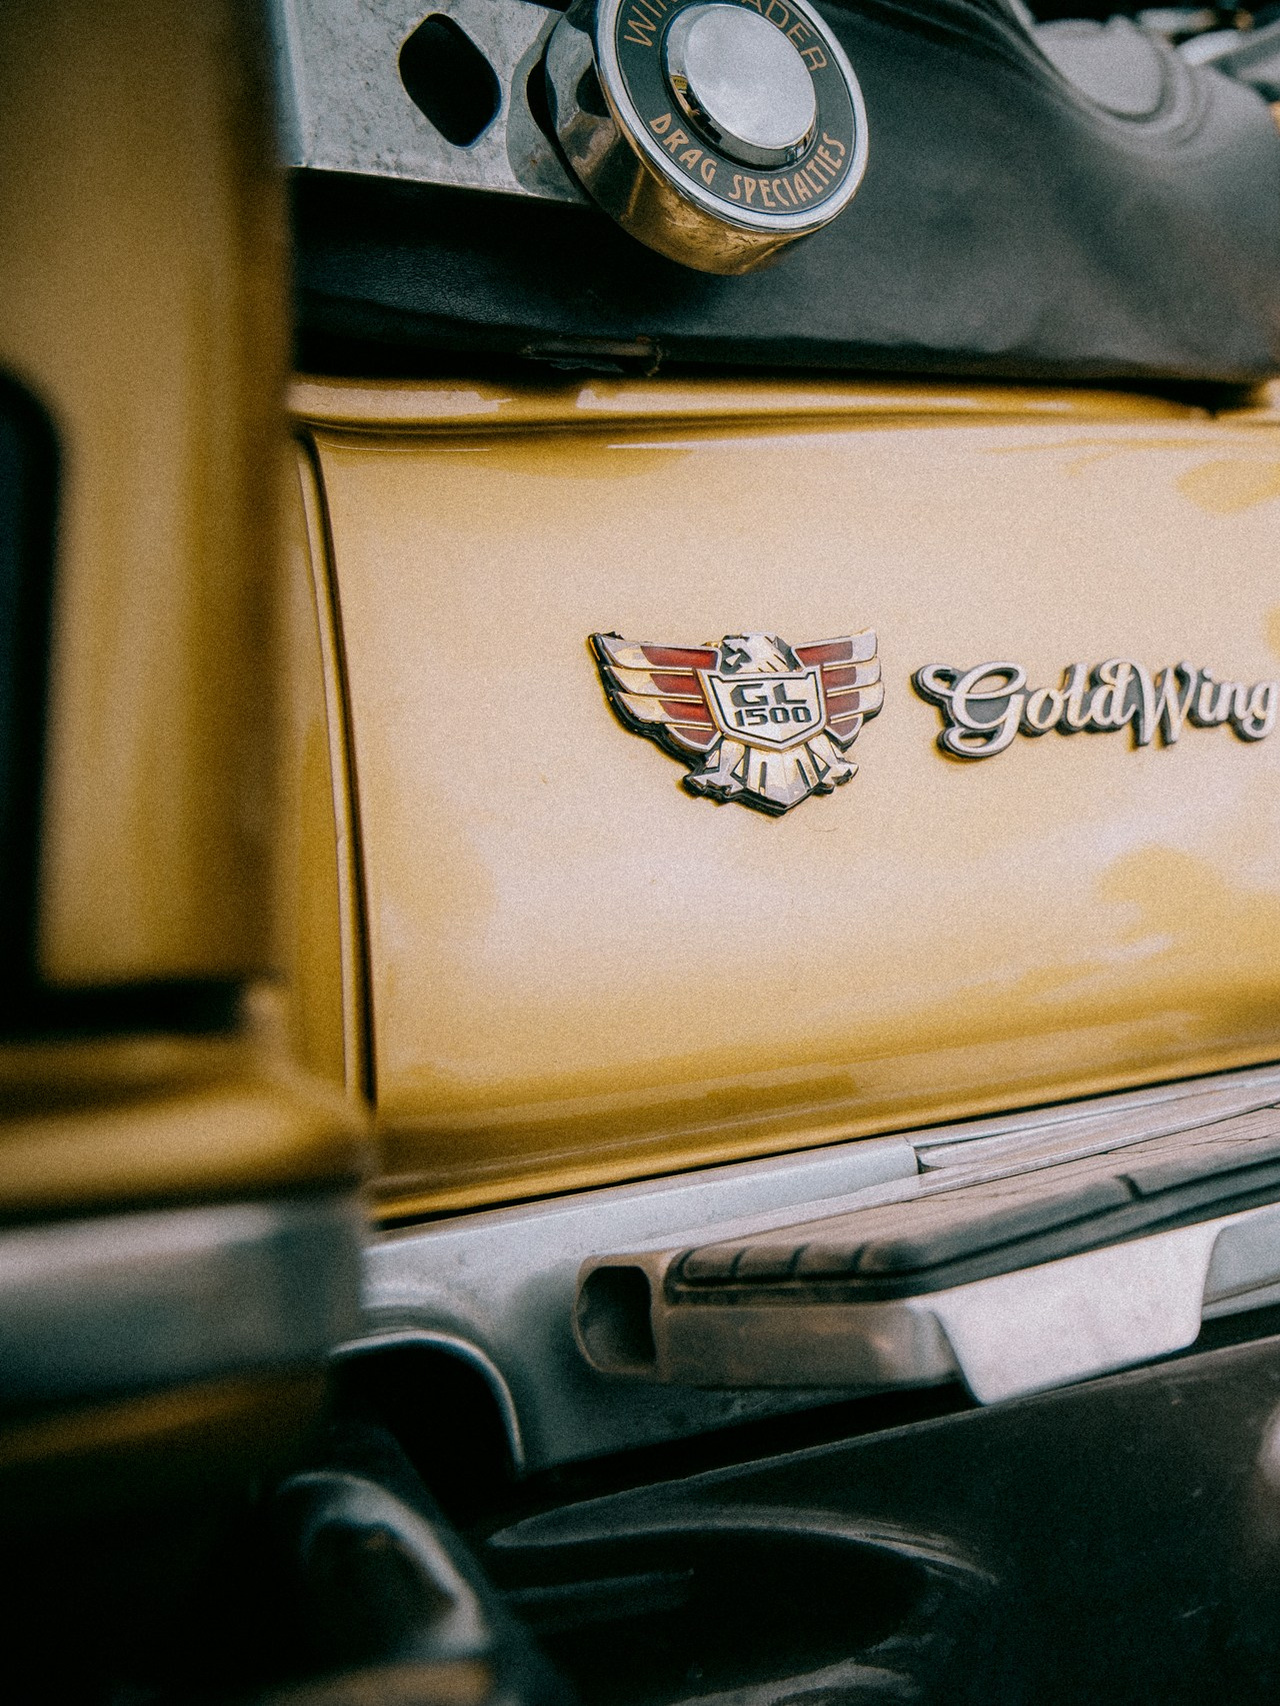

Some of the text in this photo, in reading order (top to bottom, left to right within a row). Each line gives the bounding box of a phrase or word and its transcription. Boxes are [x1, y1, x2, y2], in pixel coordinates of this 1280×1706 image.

[649, 112, 847, 208] DRAG SPECIALTIES
[730, 682, 808, 708] GL
[734, 706, 812, 727] 1500
